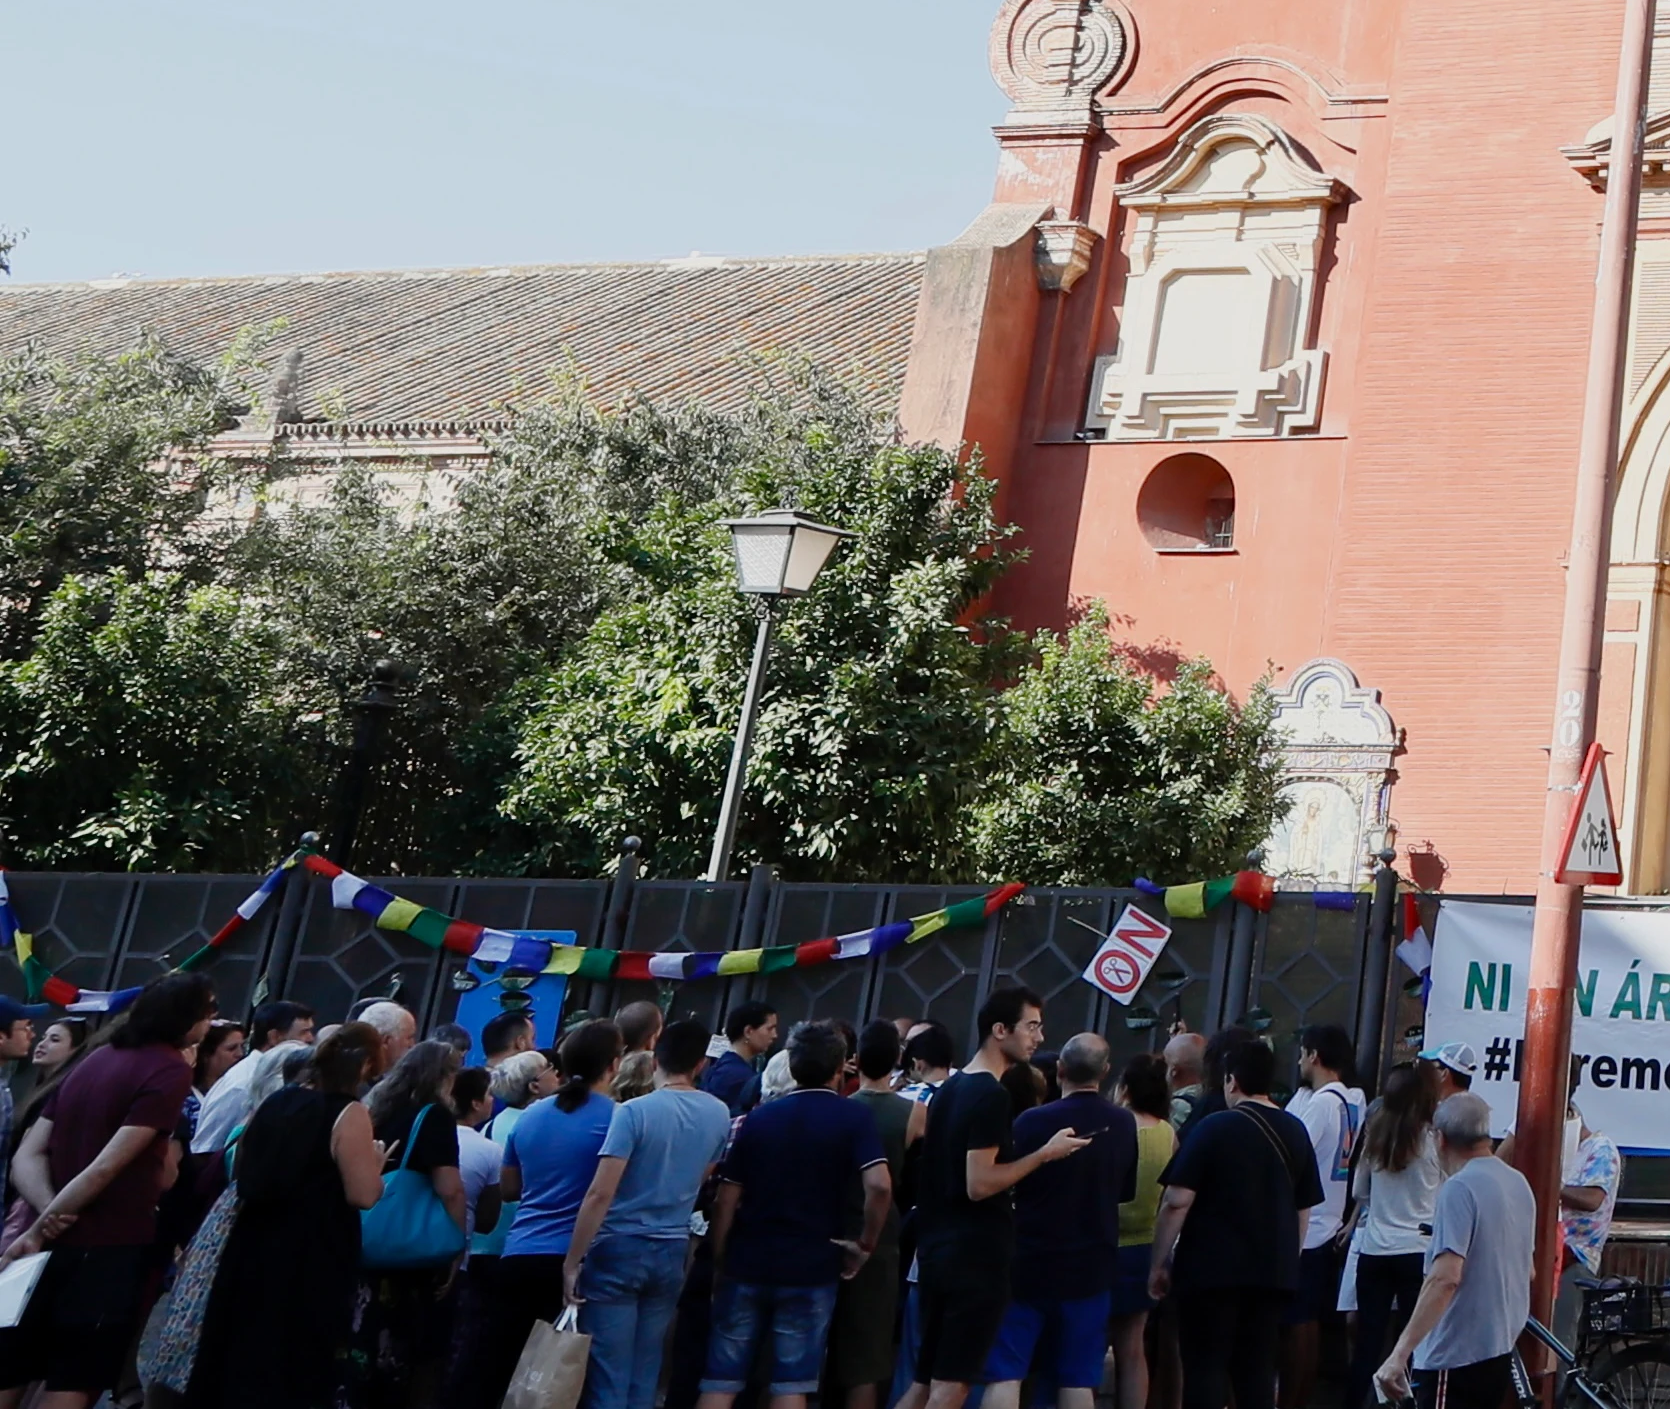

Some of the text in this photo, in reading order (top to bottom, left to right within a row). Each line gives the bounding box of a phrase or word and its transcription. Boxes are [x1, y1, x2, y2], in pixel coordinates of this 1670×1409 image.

[1559, 690, 1581, 747] 20
[1094, 908, 1168, 994] NO
[1463, 961, 1512, 1012] NI
